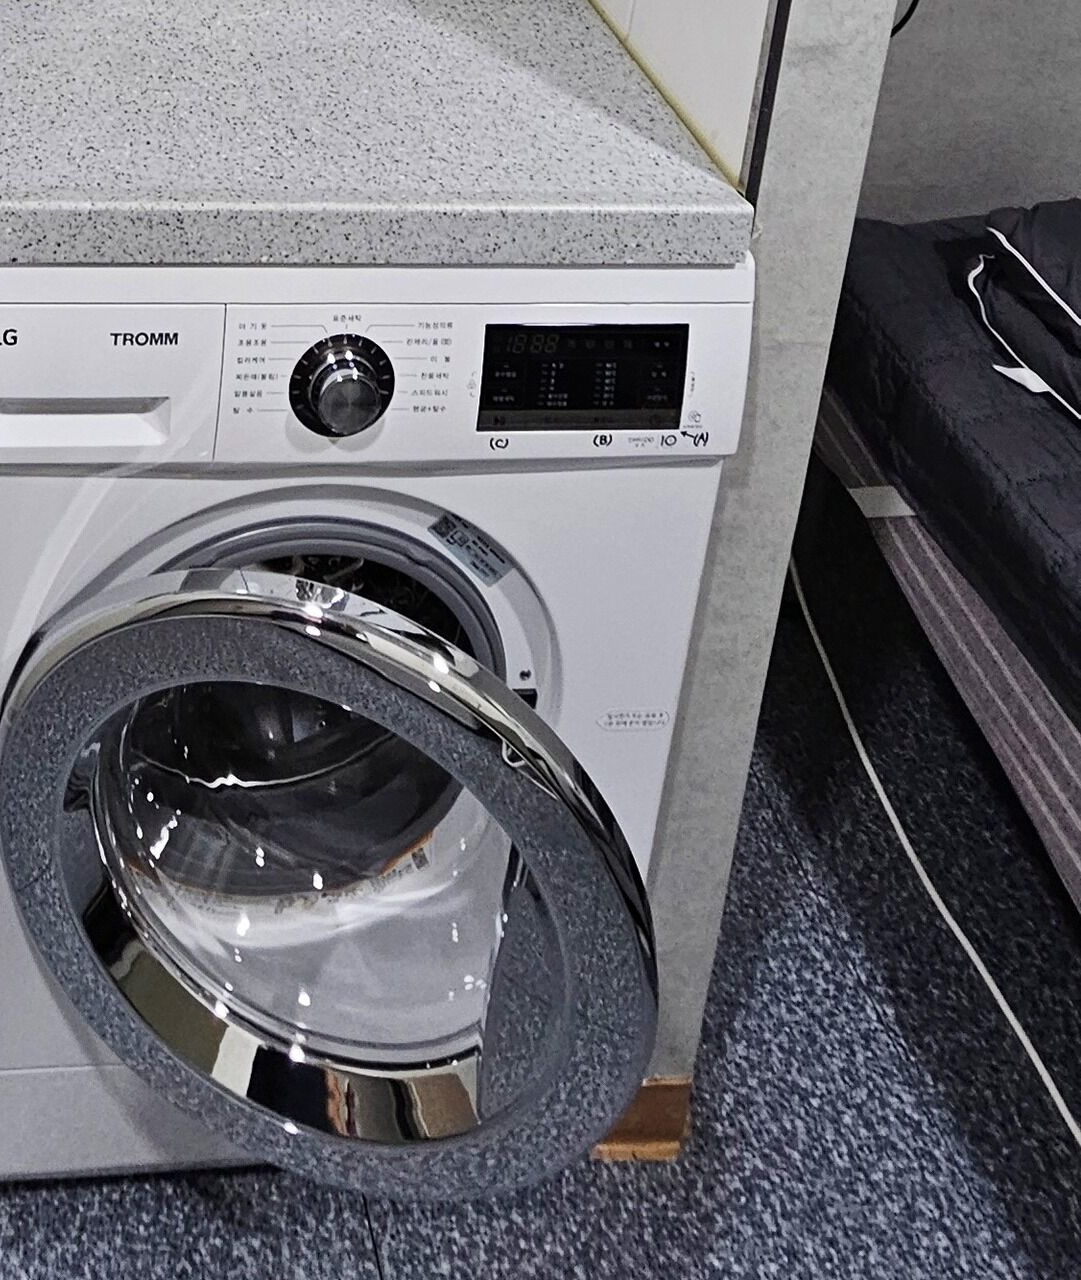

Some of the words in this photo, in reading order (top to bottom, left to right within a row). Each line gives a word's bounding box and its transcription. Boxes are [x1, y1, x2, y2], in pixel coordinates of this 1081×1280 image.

[109, 331, 179, 347] TROMM
[489, 437, 509, 451] (C)
[592, 434, 613, 448] (B)
